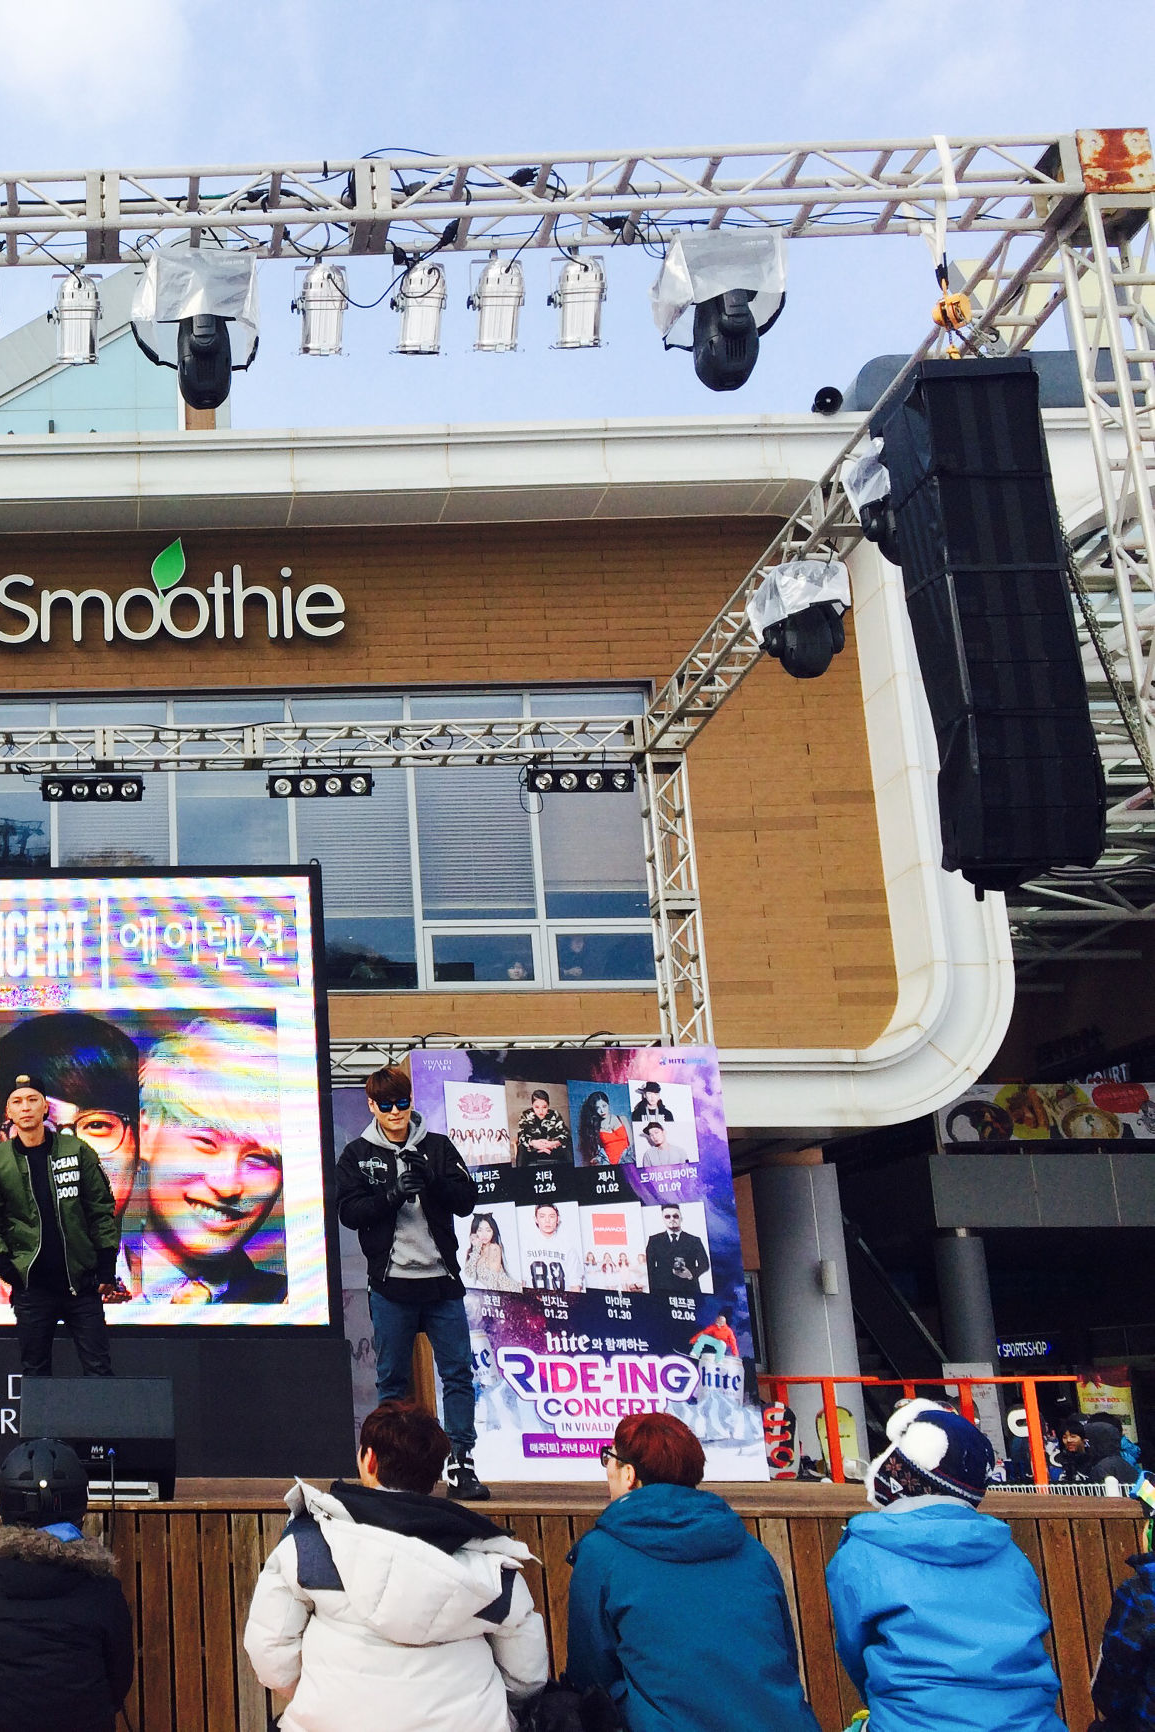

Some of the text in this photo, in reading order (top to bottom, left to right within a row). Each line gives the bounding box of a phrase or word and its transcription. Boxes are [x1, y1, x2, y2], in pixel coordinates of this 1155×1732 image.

[119, 914, 285, 973] 에이텐션
[535, 1170, 553, 1182] 치타
[597, 1170, 616, 1182] 제시
[56, 1186, 79, 1199] GOOD
[477, 1183, 496, 1193] 2.19
[533, 1183, 557, 1193] 12.26
[596, 1183, 620, 1194] 01.02
[658, 1182, 682, 1193] 01.09
[483, 1294, 501, 1307] 효린
[541, 1295, 569, 1308] 빈지노
[605, 1295, 632, 1309] 마마무
[668, 1296, 696, 1310] 데프콘
[481, 1307, 505, 1319] 01.16
[544, 1308, 569, 1320] 01.23
[607, 1308, 632, 1320] 01.30
[671, 1309, 696, 1321] 02.06
[544, 1330, 590, 1352] hite
[605, 1337, 649, 1352] 함께하는
[503, 1353, 692, 1394] RIDE-ING
[702, 1366, 742, 1391] hite
[543, 1397, 661, 1417] CONCERT
[561, 1422, 614, 1432] IN VIVALDI
[90, 1445, 104, 1454] M4
